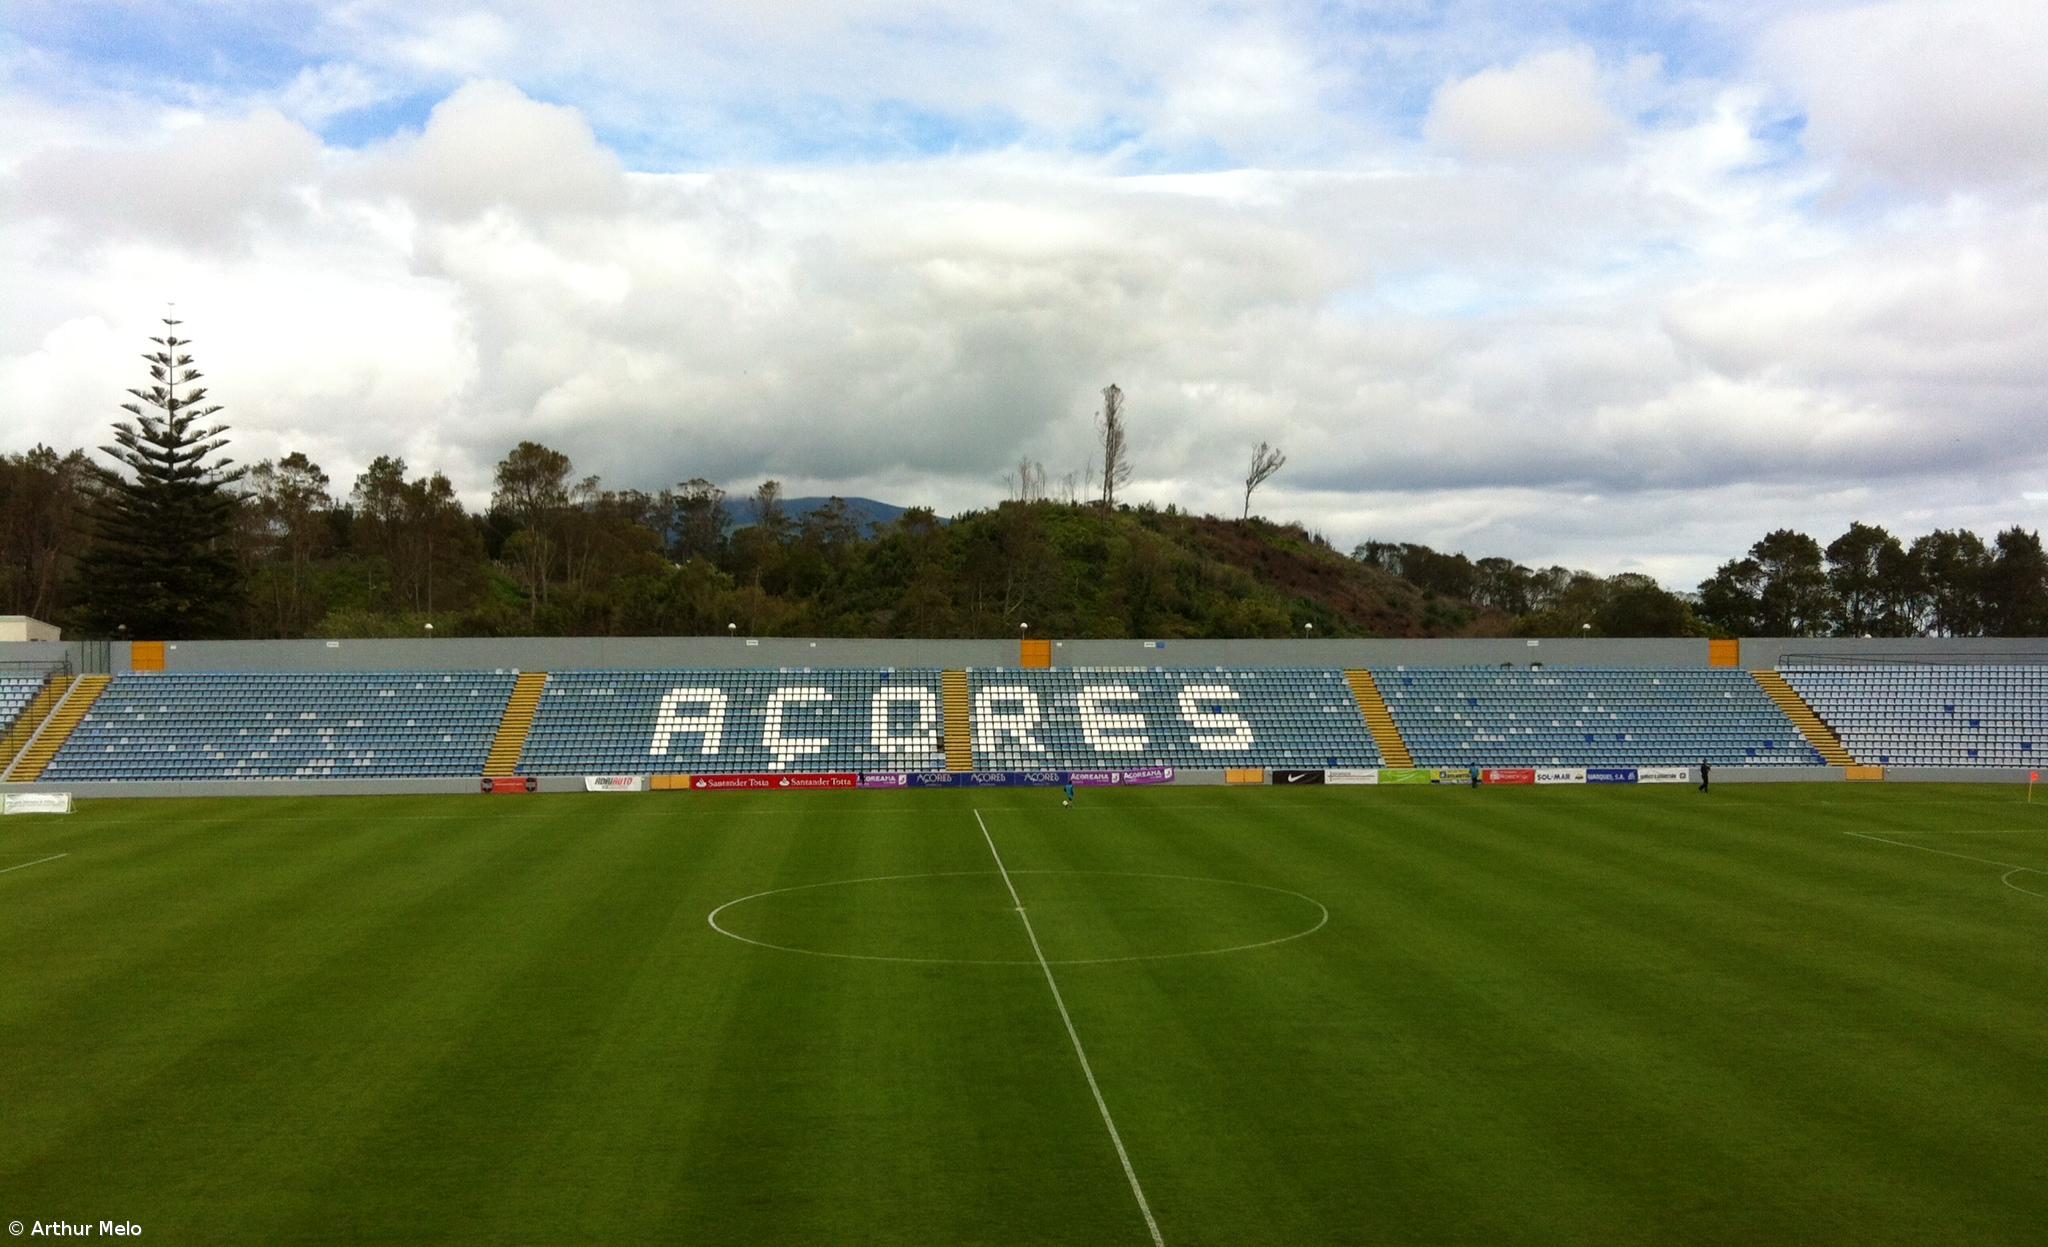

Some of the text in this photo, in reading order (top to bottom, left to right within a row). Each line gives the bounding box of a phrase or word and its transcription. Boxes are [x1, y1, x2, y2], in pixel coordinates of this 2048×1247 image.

[649, 685, 1255, 770] AÇORES
[708, 778, 769, 787] Santander Totta
[791, 777, 851, 786] Santander Totta
[916, 773, 953, 784] AÇORES
[971, 773, 1006, 784] AÇORES
[1024, 772, 1060, 783] AÇORES
